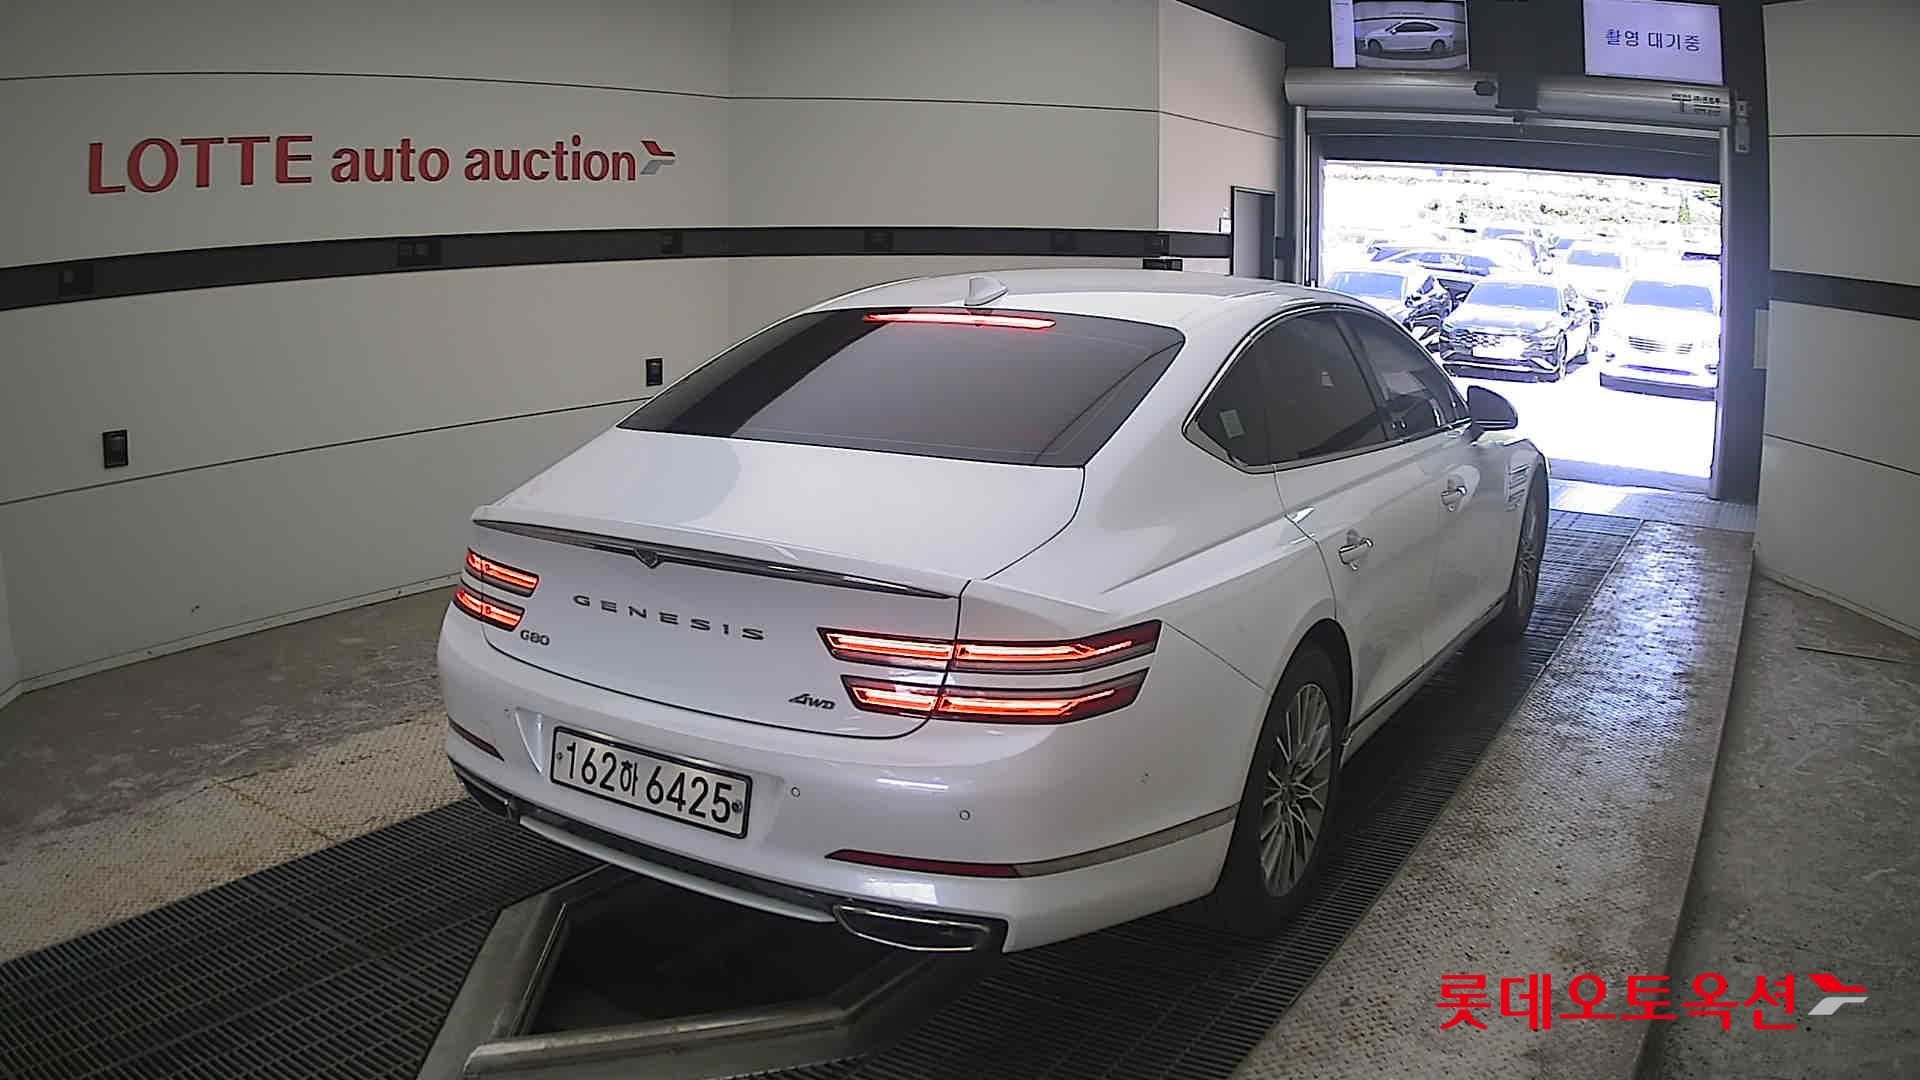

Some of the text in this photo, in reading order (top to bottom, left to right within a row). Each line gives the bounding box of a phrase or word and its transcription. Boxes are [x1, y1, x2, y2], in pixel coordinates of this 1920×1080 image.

[87, 134, 638, 195] LOTTE auto auction
[572, 594, 765, 641] GENESIS
[519, 628, 551, 647] G80
[788, 692, 837, 711] AWD
